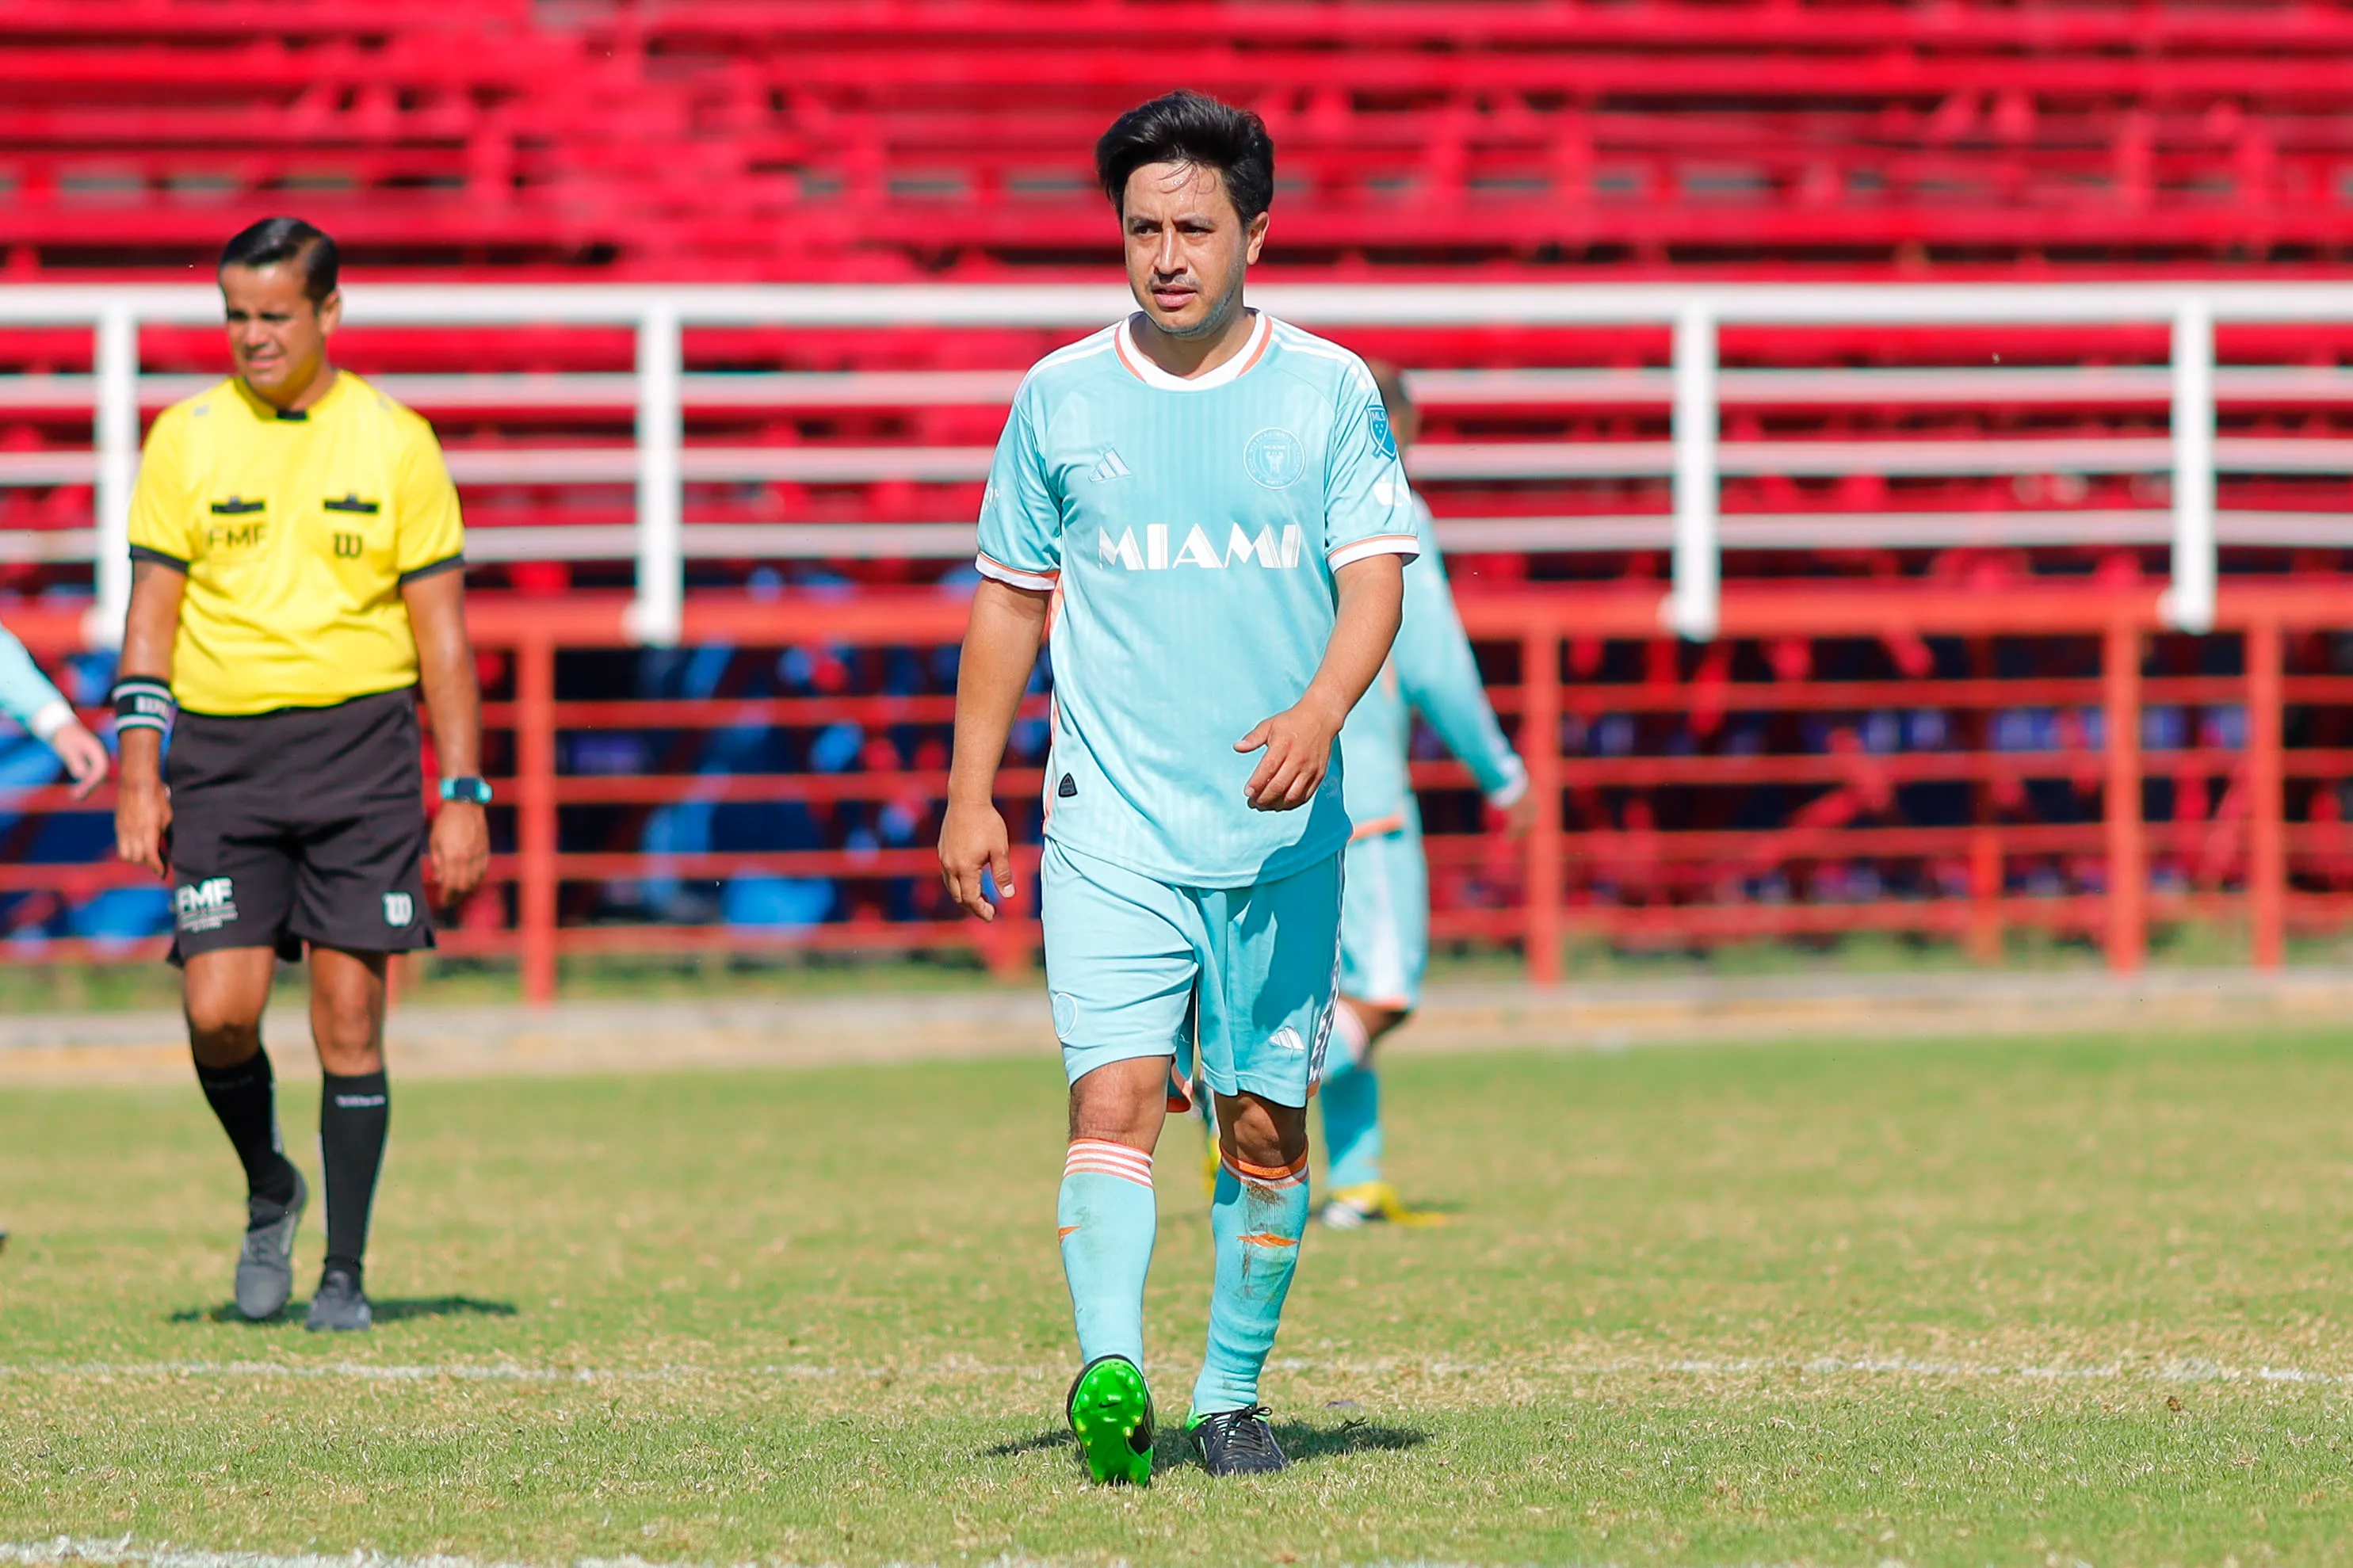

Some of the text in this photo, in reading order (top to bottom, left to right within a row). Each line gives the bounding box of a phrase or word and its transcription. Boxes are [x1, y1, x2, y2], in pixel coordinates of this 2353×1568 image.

[208, 523, 267, 547] FMF
[1098, 522, 1301, 570] MIAMI
[176, 876, 233, 911] FMF
